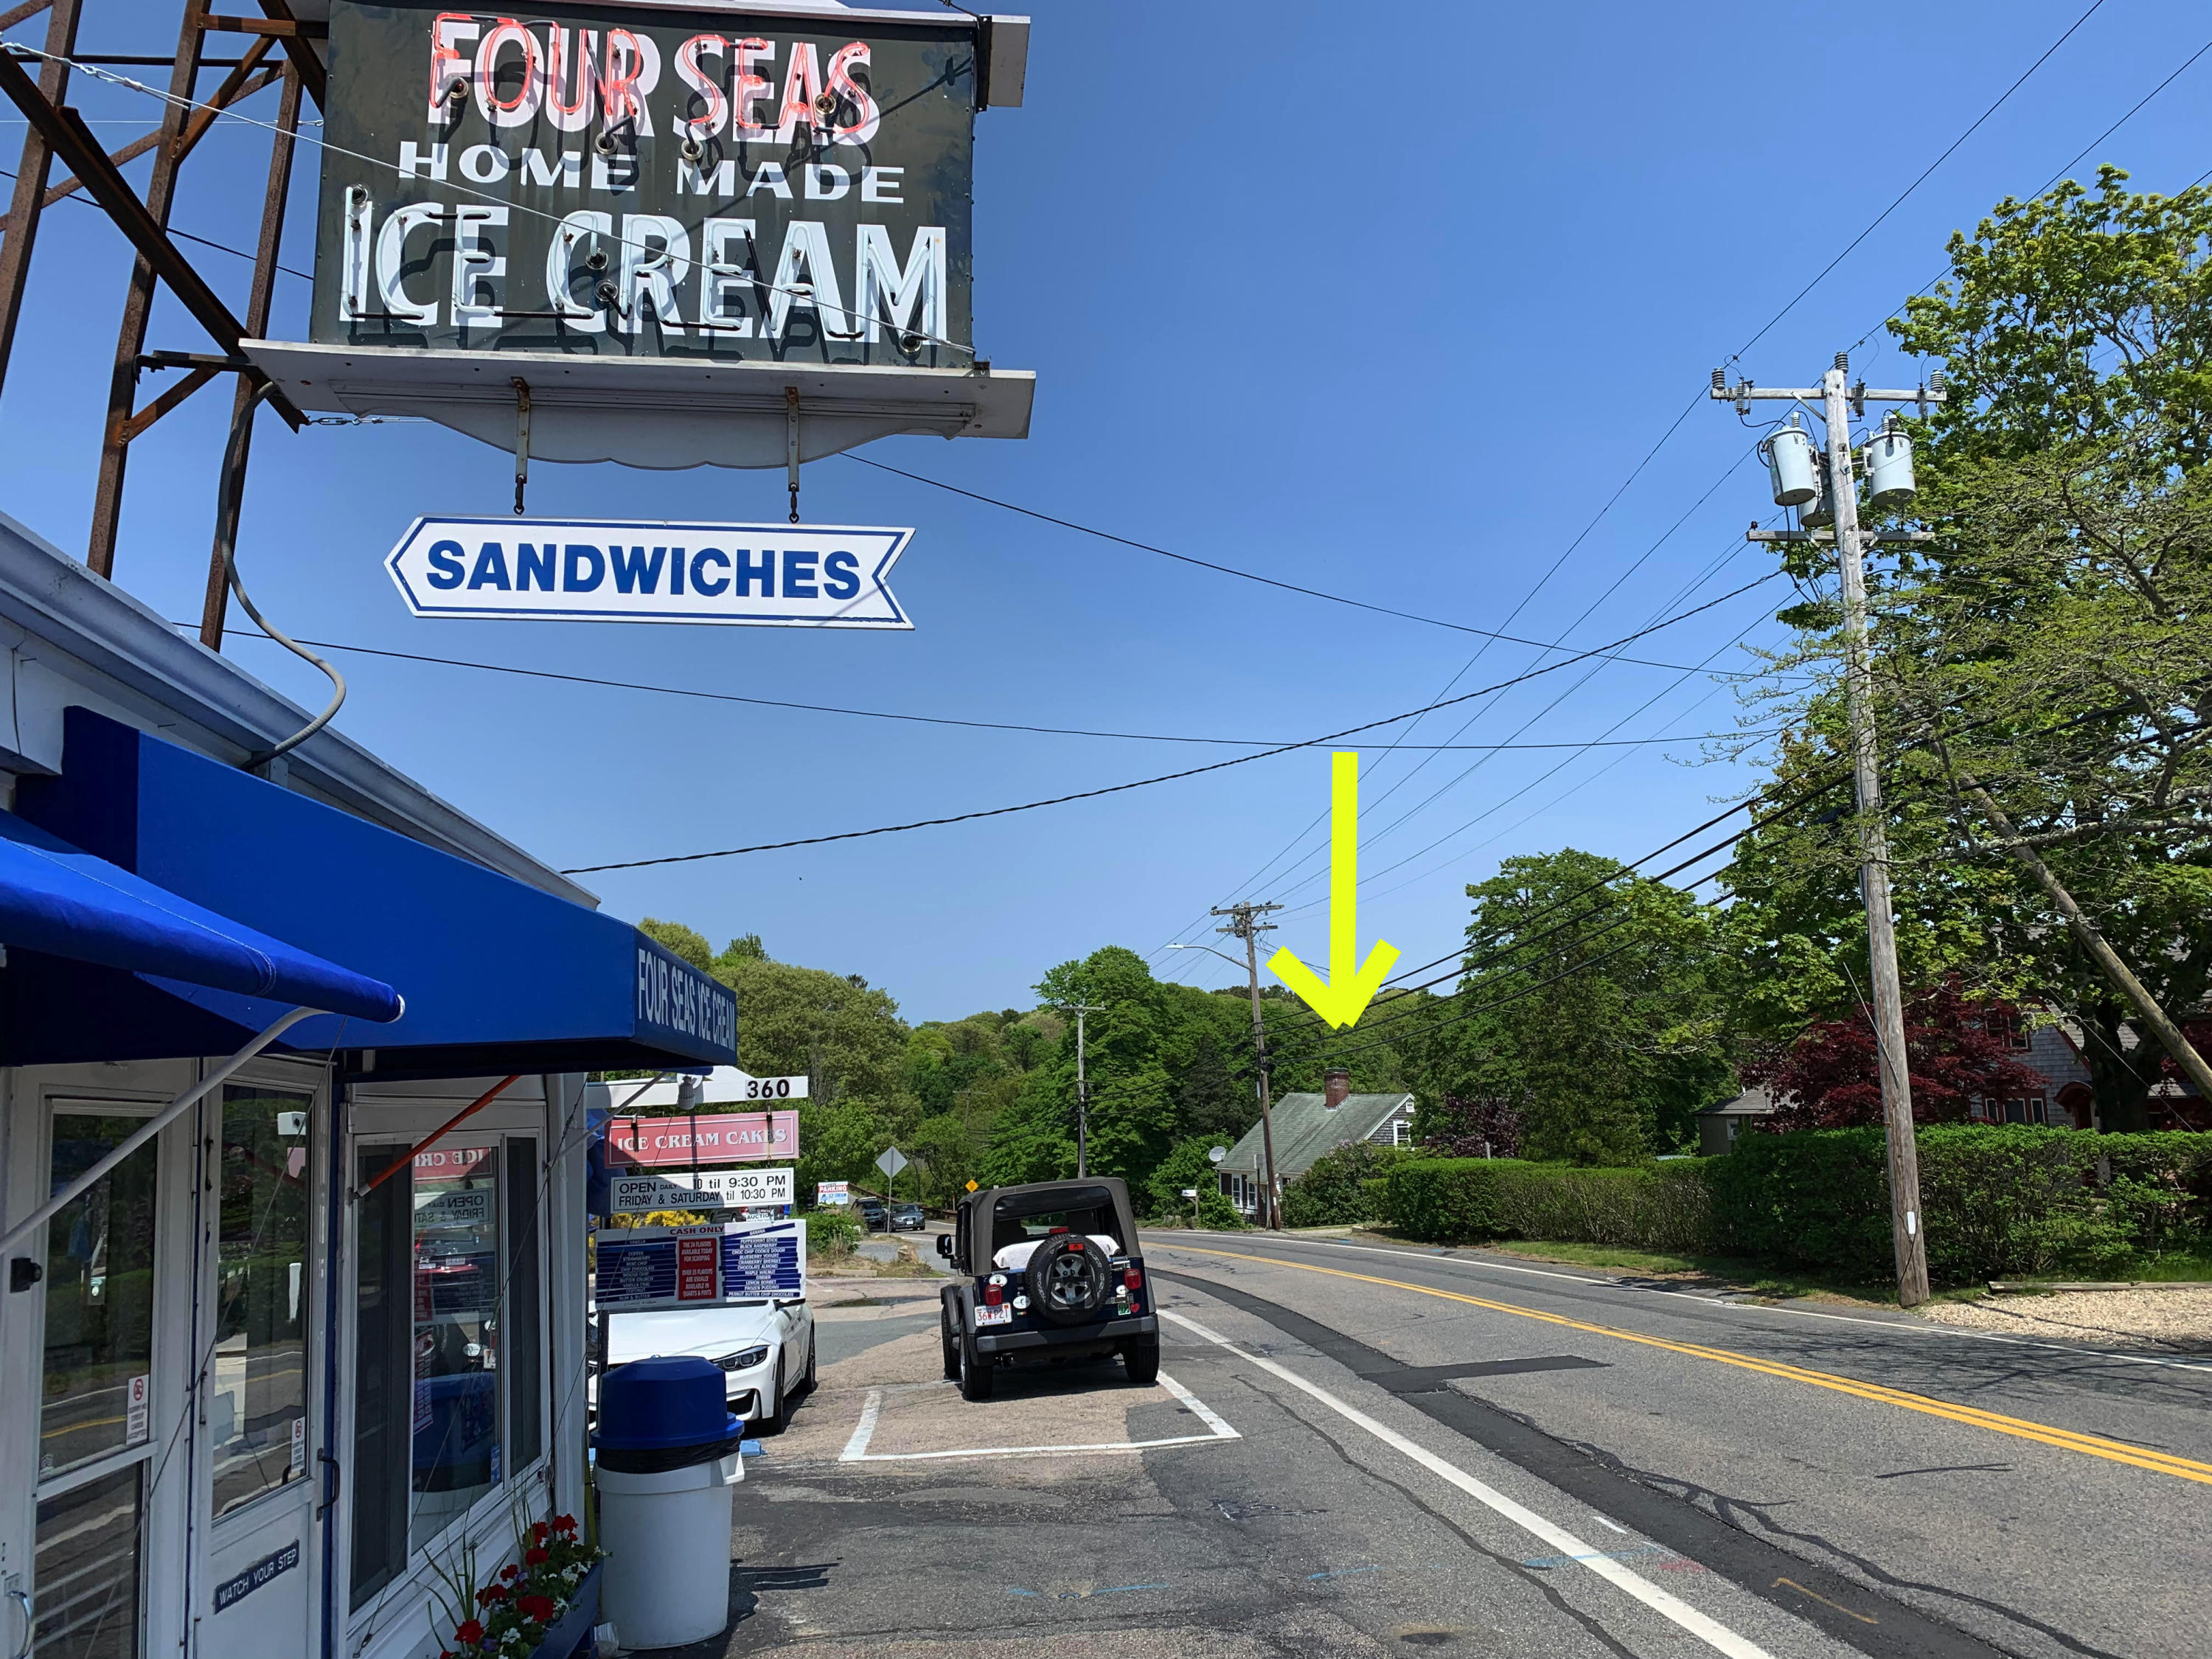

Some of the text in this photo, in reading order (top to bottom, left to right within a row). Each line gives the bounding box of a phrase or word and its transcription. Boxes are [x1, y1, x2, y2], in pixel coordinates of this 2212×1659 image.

[428, 13, 881, 146] FOUR SEAS
[399, 140, 905, 204] HOME MADE
[339, 189, 949, 347] ICE CREAM
[425, 539, 861, 600] SANDWICHES
[639, 948, 736, 1051] FOUR SEAS ICE CREAM
[746, 1079, 790, 1099] 360
[618, 1128, 787, 1151] ICE CREAM CAKES
[619, 1181, 656, 1194] OPEN
[693, 1179, 703, 1189] 10
[709, 1178, 720, 1189] til
[728, 1176, 758, 1188] 9:30
[766, 1175, 785, 1186] PM
[619, 1188, 785, 1206] FRIDAY & SATURDAY til 10:30 PM
[699, 1225, 724, 1234] ONLY
[219, 1548, 296, 1606] WATCH YOUR STEP
